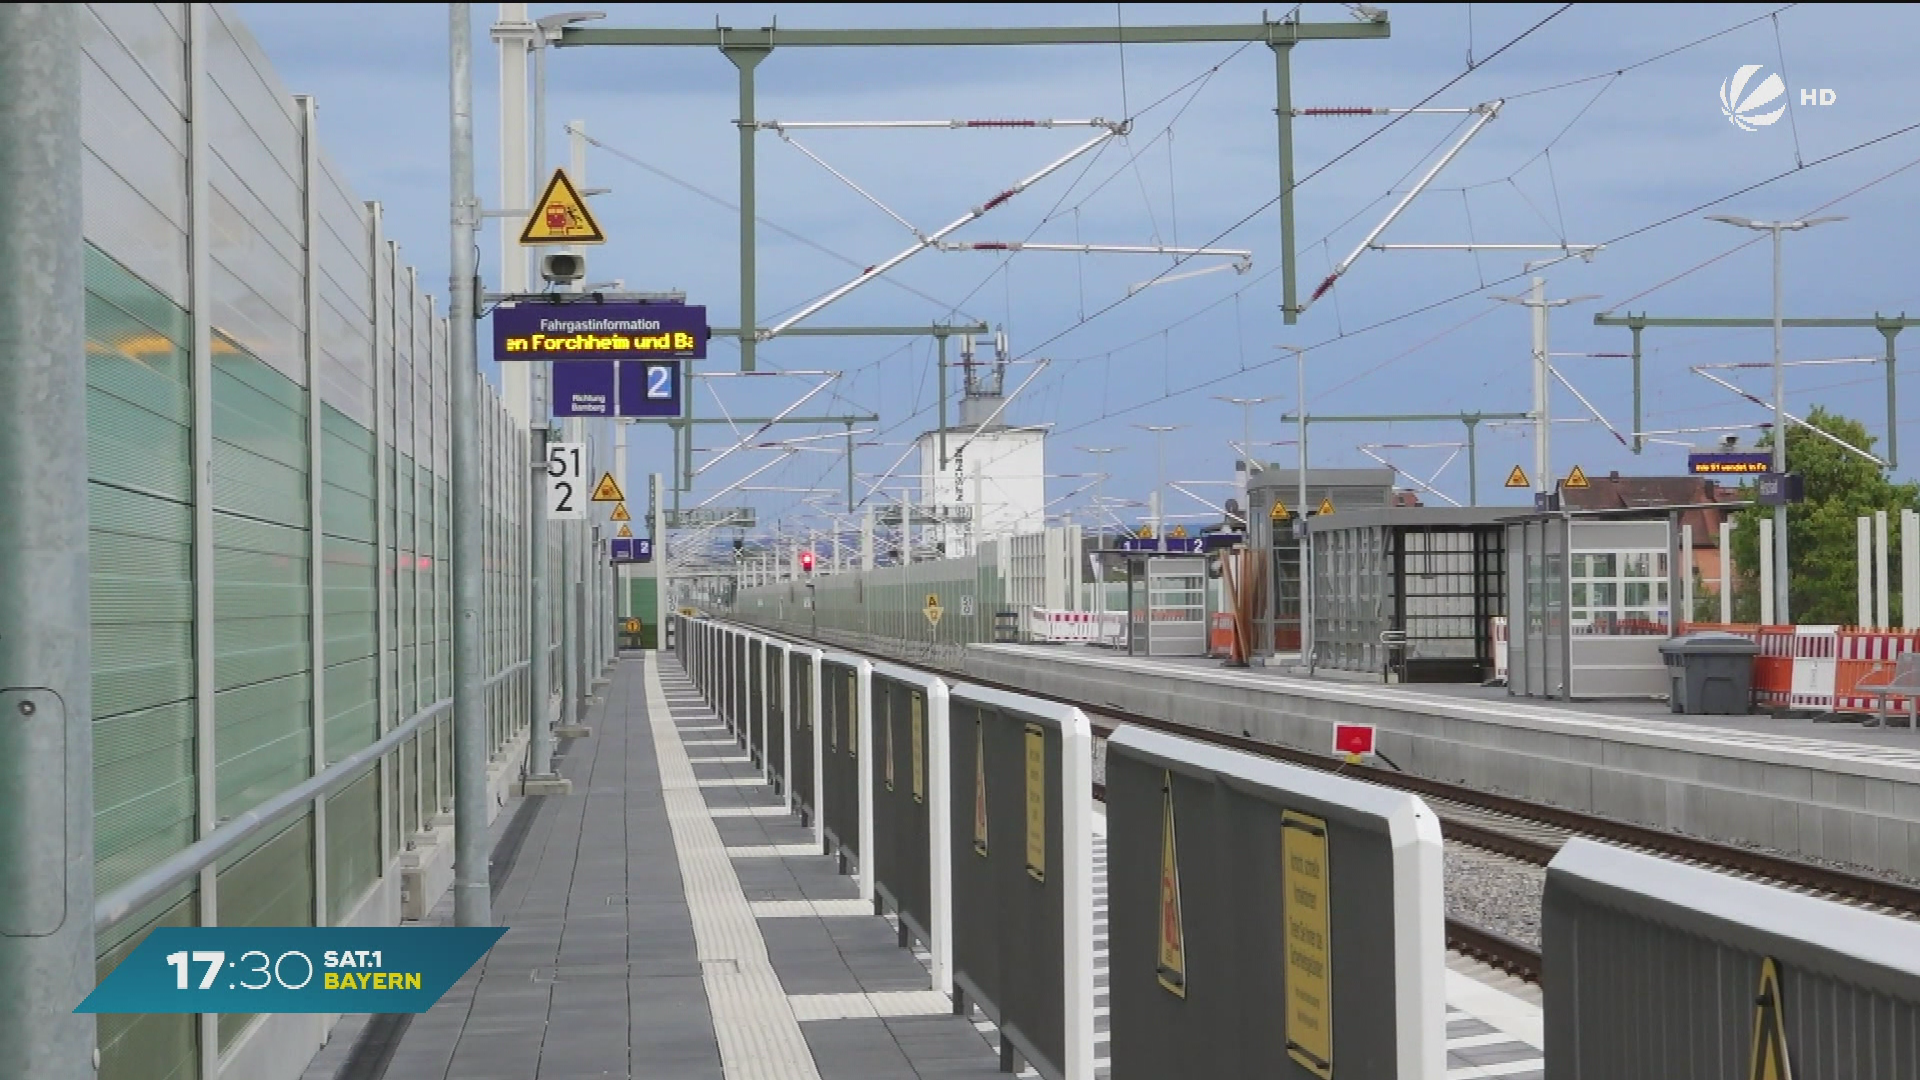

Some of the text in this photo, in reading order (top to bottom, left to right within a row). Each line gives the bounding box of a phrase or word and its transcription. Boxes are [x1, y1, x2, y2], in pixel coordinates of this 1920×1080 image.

[540, 319, 660, 333] Fahrgastinformation
[531, 333, 631, 351] Forchheim
[633, 332, 670, 349] und
[647, 366, 669, 398] 2
[548, 447, 580, 477] 51
[555, 482, 573, 512] 2
[1193, 538, 1203, 553] 2
